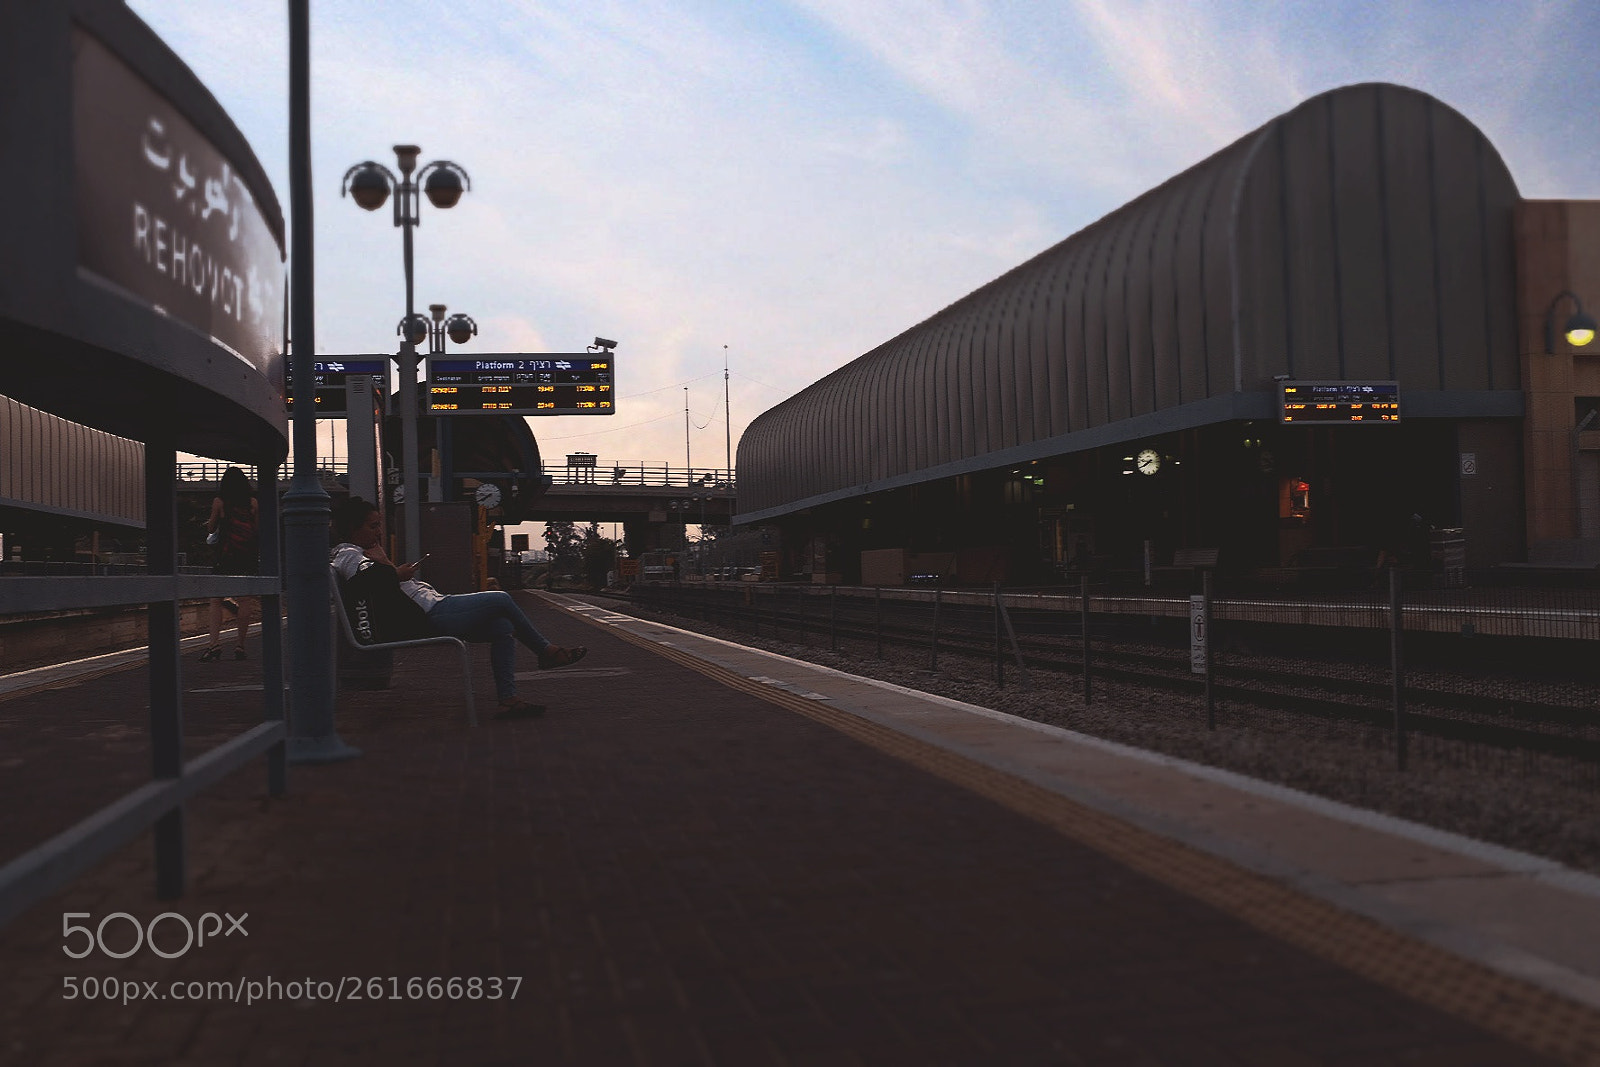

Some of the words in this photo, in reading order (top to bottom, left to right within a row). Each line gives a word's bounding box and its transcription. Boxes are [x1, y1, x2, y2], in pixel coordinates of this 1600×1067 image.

[133, 202, 246, 322] REHOVOT
[476, 360, 515, 370] Platform
[518, 360, 525, 369] 2
[529, 360, 551, 371] רציף
